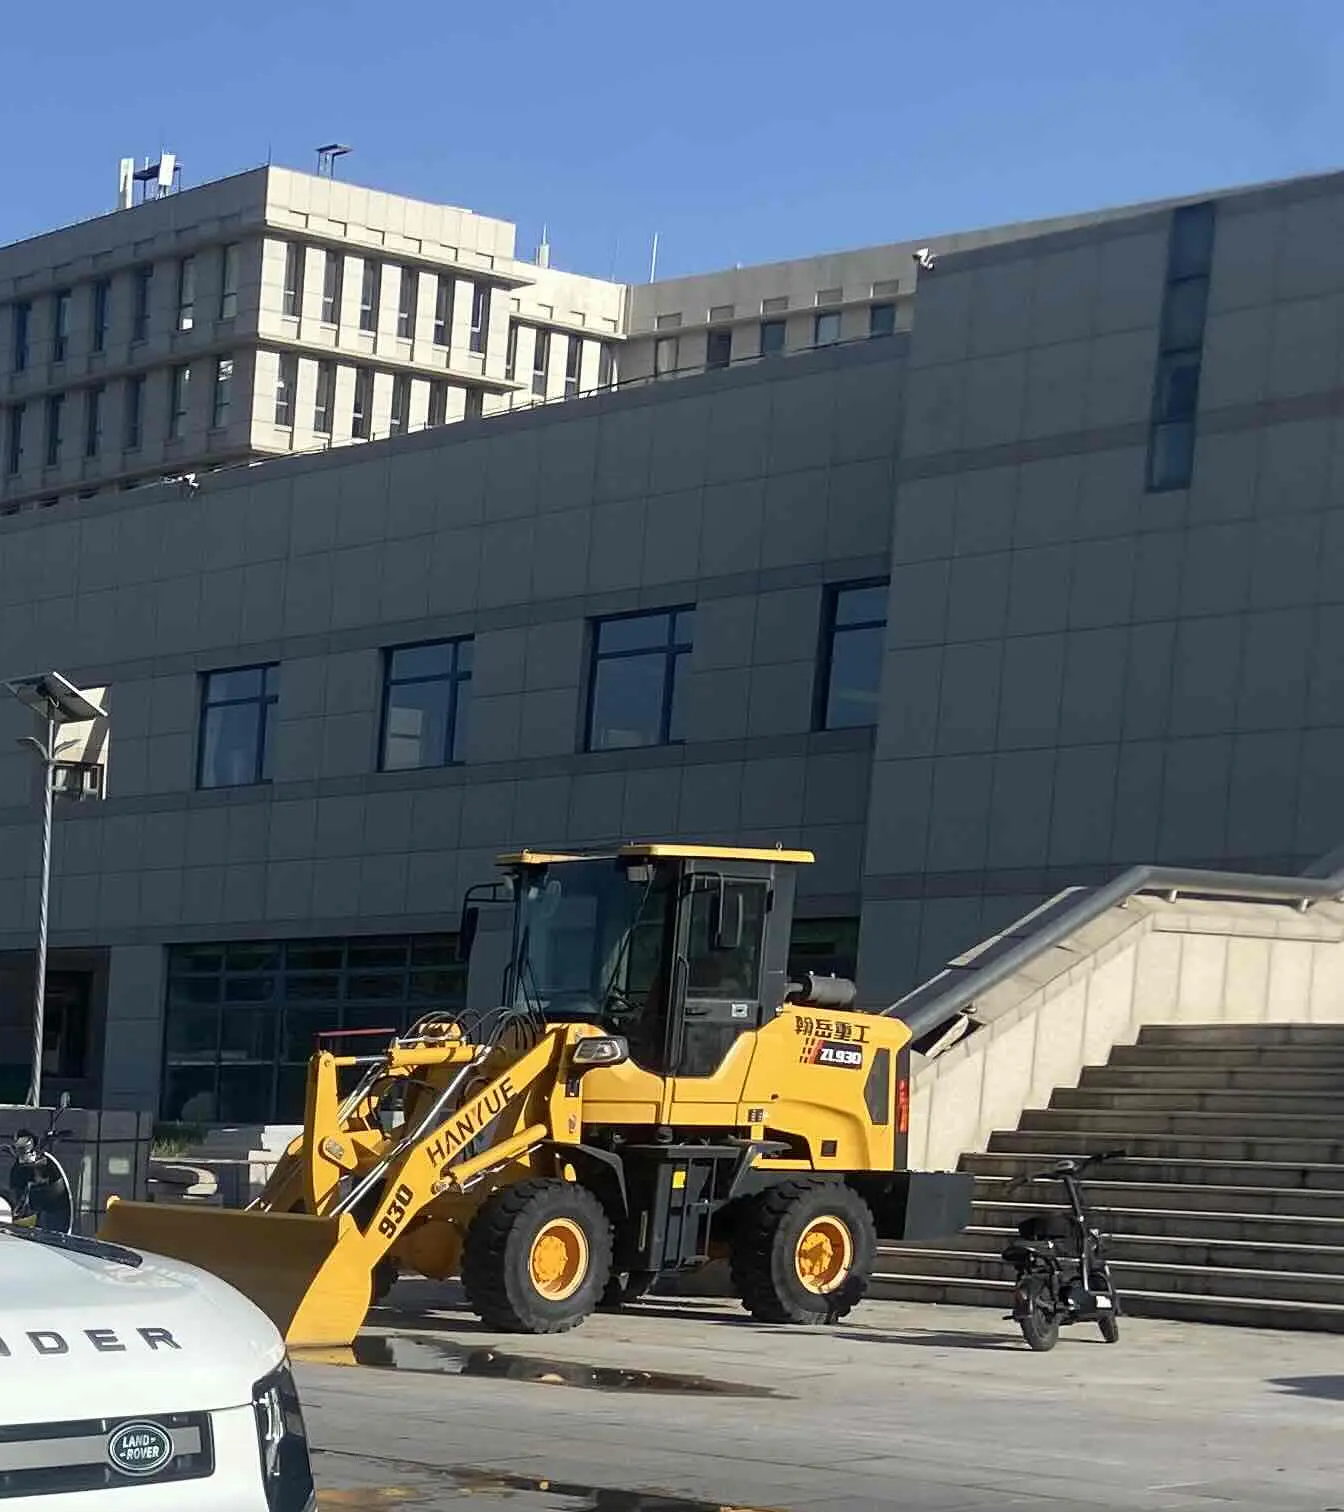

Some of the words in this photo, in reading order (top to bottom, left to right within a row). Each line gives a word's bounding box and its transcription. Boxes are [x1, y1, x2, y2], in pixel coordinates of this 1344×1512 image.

[794, 1016, 871, 1044] 翰岳重工
[820, 1048, 862, 1065] ZL930
[424, 1077, 516, 1168] HANYUE
[378, 1184, 414, 1239] 930
[123, 1434, 150, 1449] LAND
[126, 1445, 160, 1460] ROVER
